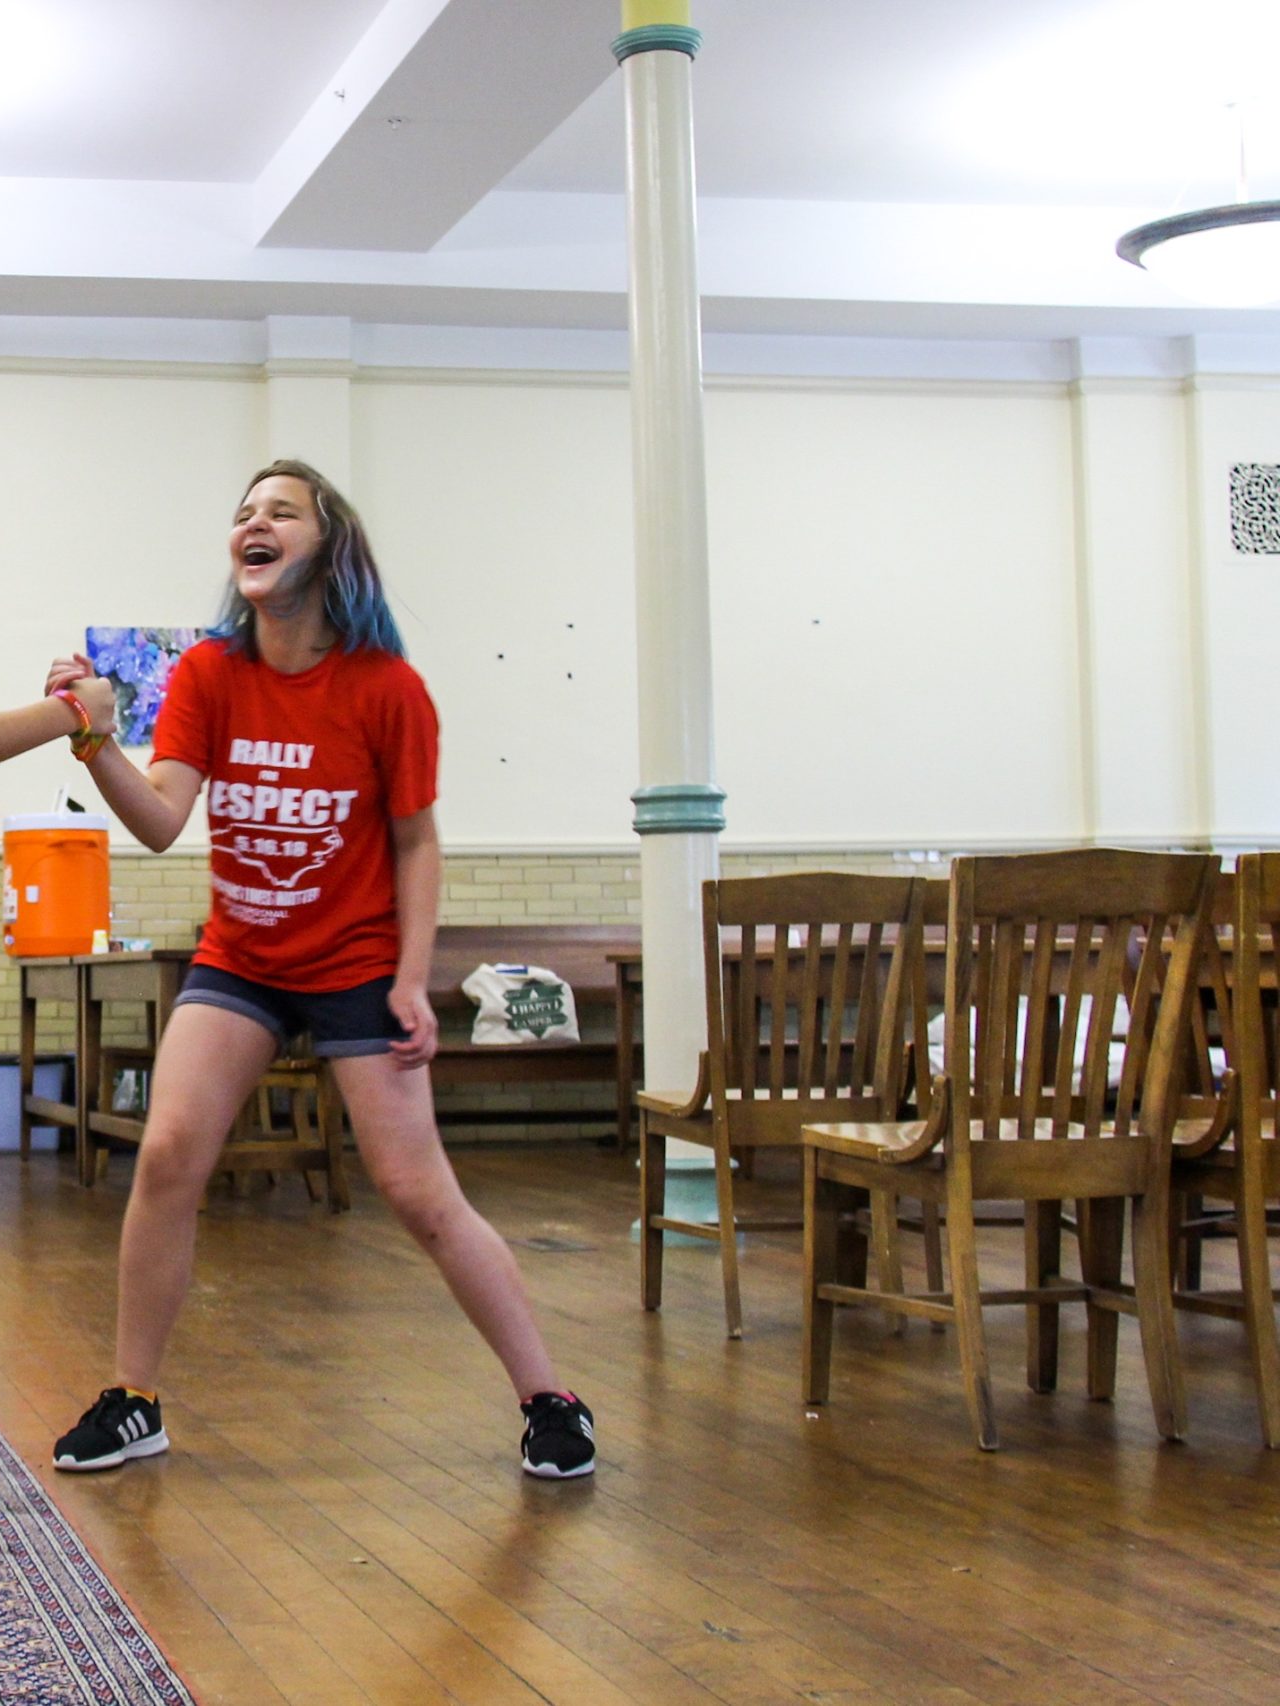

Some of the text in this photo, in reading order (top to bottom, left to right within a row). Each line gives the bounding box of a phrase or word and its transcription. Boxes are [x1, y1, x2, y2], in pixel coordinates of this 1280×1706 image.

[229, 738, 315, 769] RALLY
[210, 780, 359, 825] ESPECT
[519, 1003, 551, 1015] HAPPY
